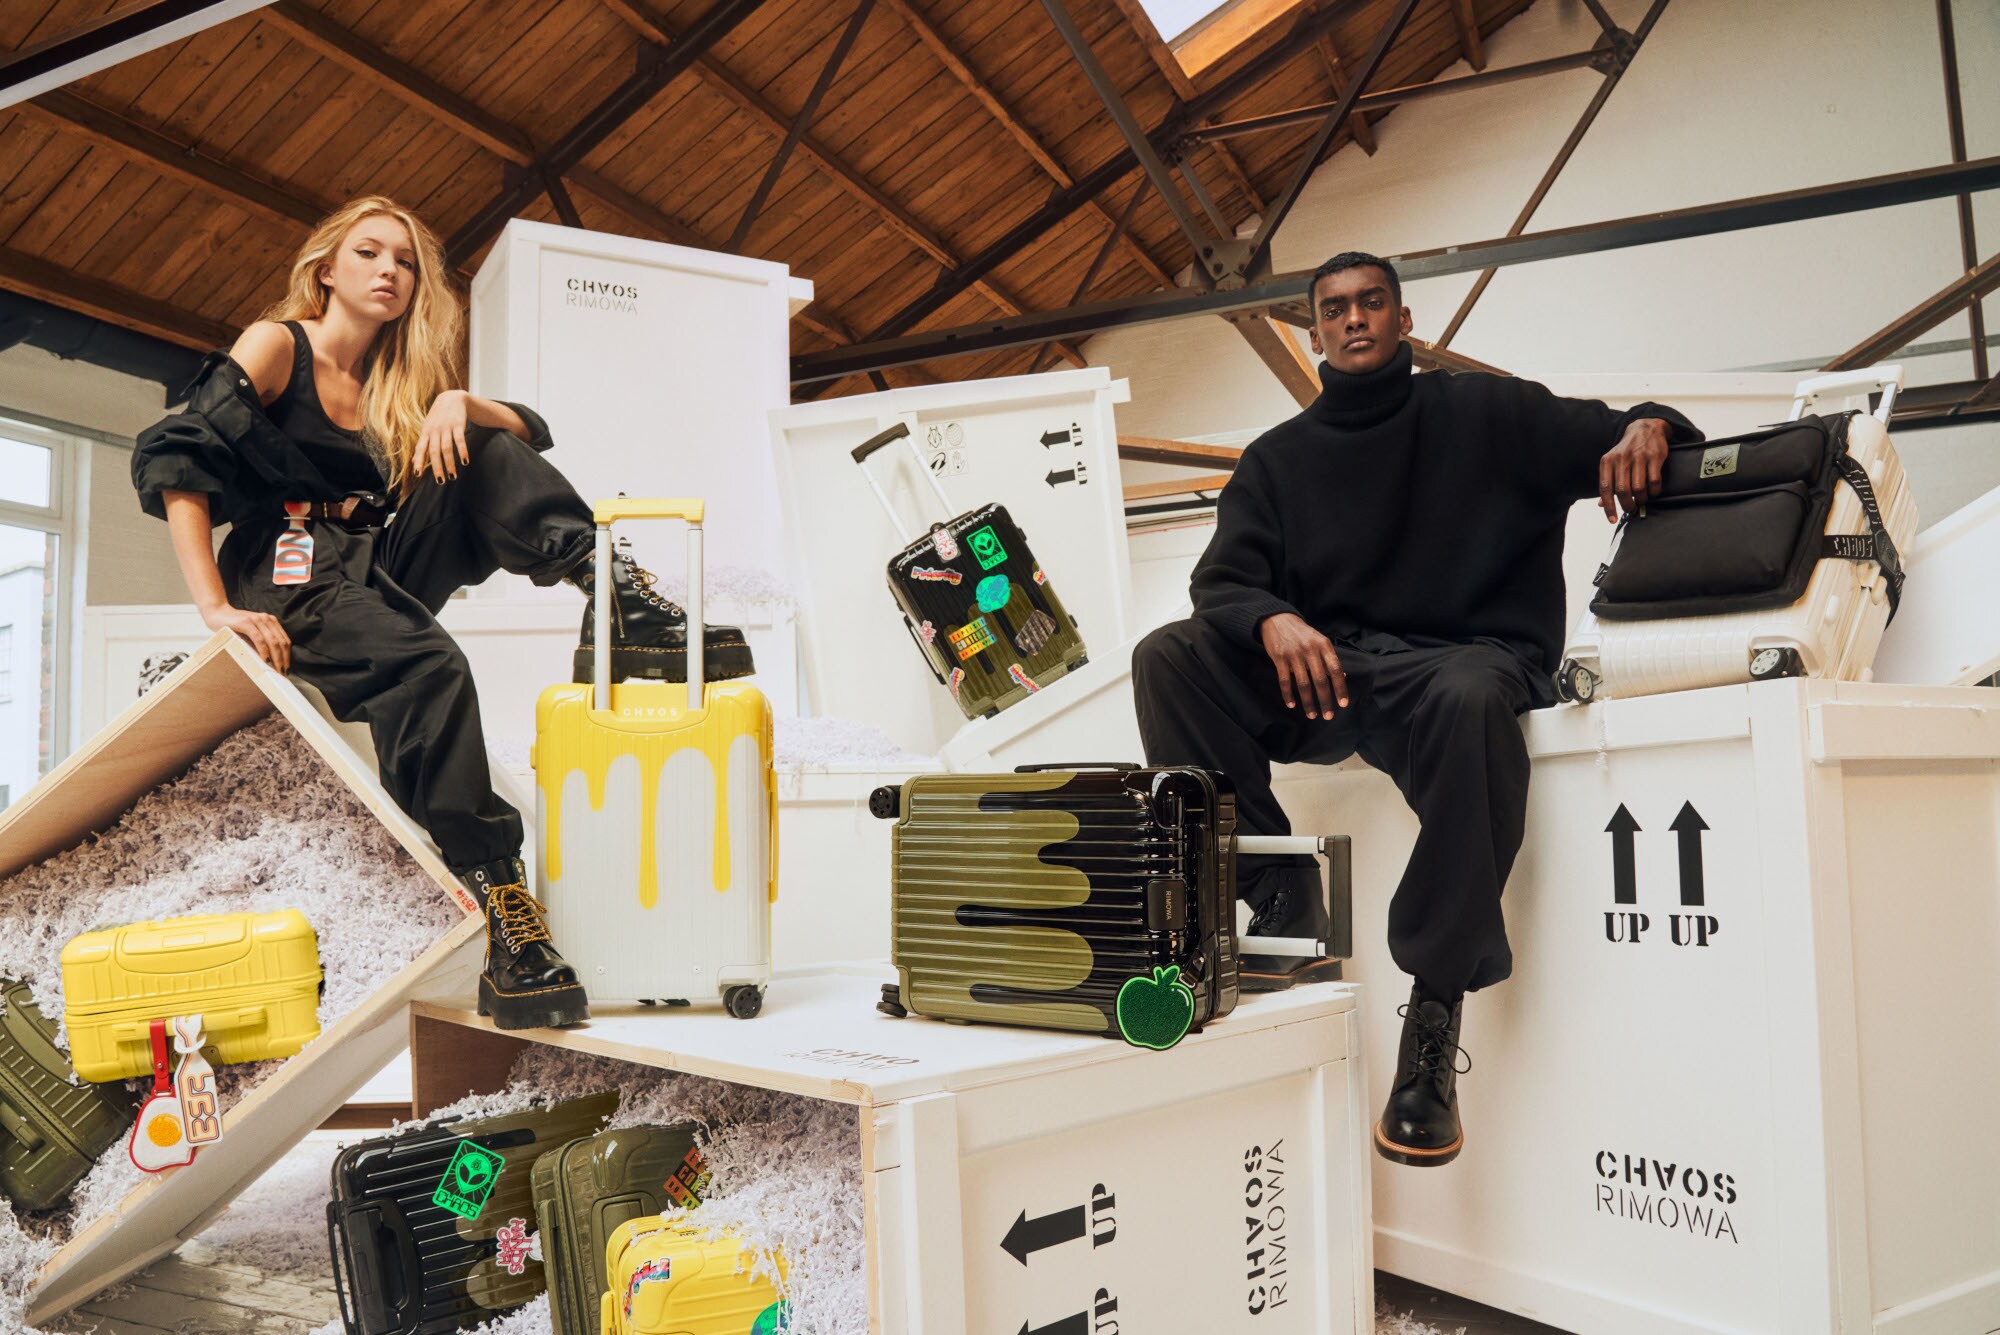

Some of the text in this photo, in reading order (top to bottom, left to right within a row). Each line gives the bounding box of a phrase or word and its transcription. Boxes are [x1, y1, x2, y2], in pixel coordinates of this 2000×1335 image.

[566, 292, 638, 315] RIMOWA
[1603, 911, 1719, 947] UP UP
[435, 1190, 479, 1218] CHAOS
[1091, 1182, 1117, 1250] UP
[1266, 1138, 1288, 1308] RIMOWA
[1595, 1183, 1739, 1245] RIMOWA
[509, 1219, 527, 1274] HANDS
